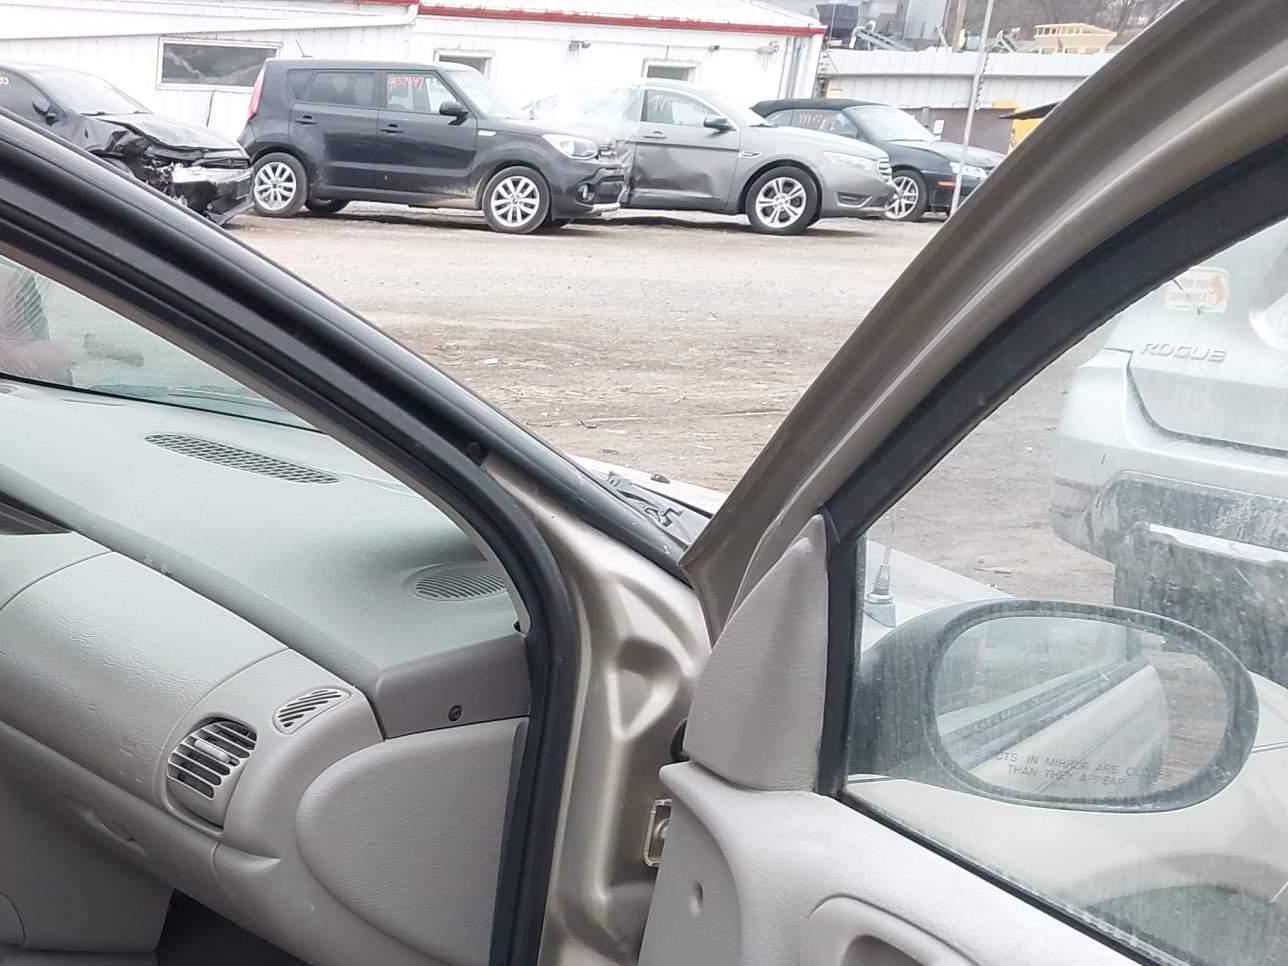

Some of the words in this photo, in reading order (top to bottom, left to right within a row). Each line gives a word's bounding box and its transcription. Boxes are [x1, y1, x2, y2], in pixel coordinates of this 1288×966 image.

[1141, 343, 1228, 363] ROGUE
[1026, 754, 1039, 765] IN
[1044, 757, 1089, 771] MIRROR
[1095, 763, 1120, 774] ARE
[1007, 764, 1037, 777] THAN
[1079, 773, 1126, 786] APPEAR
